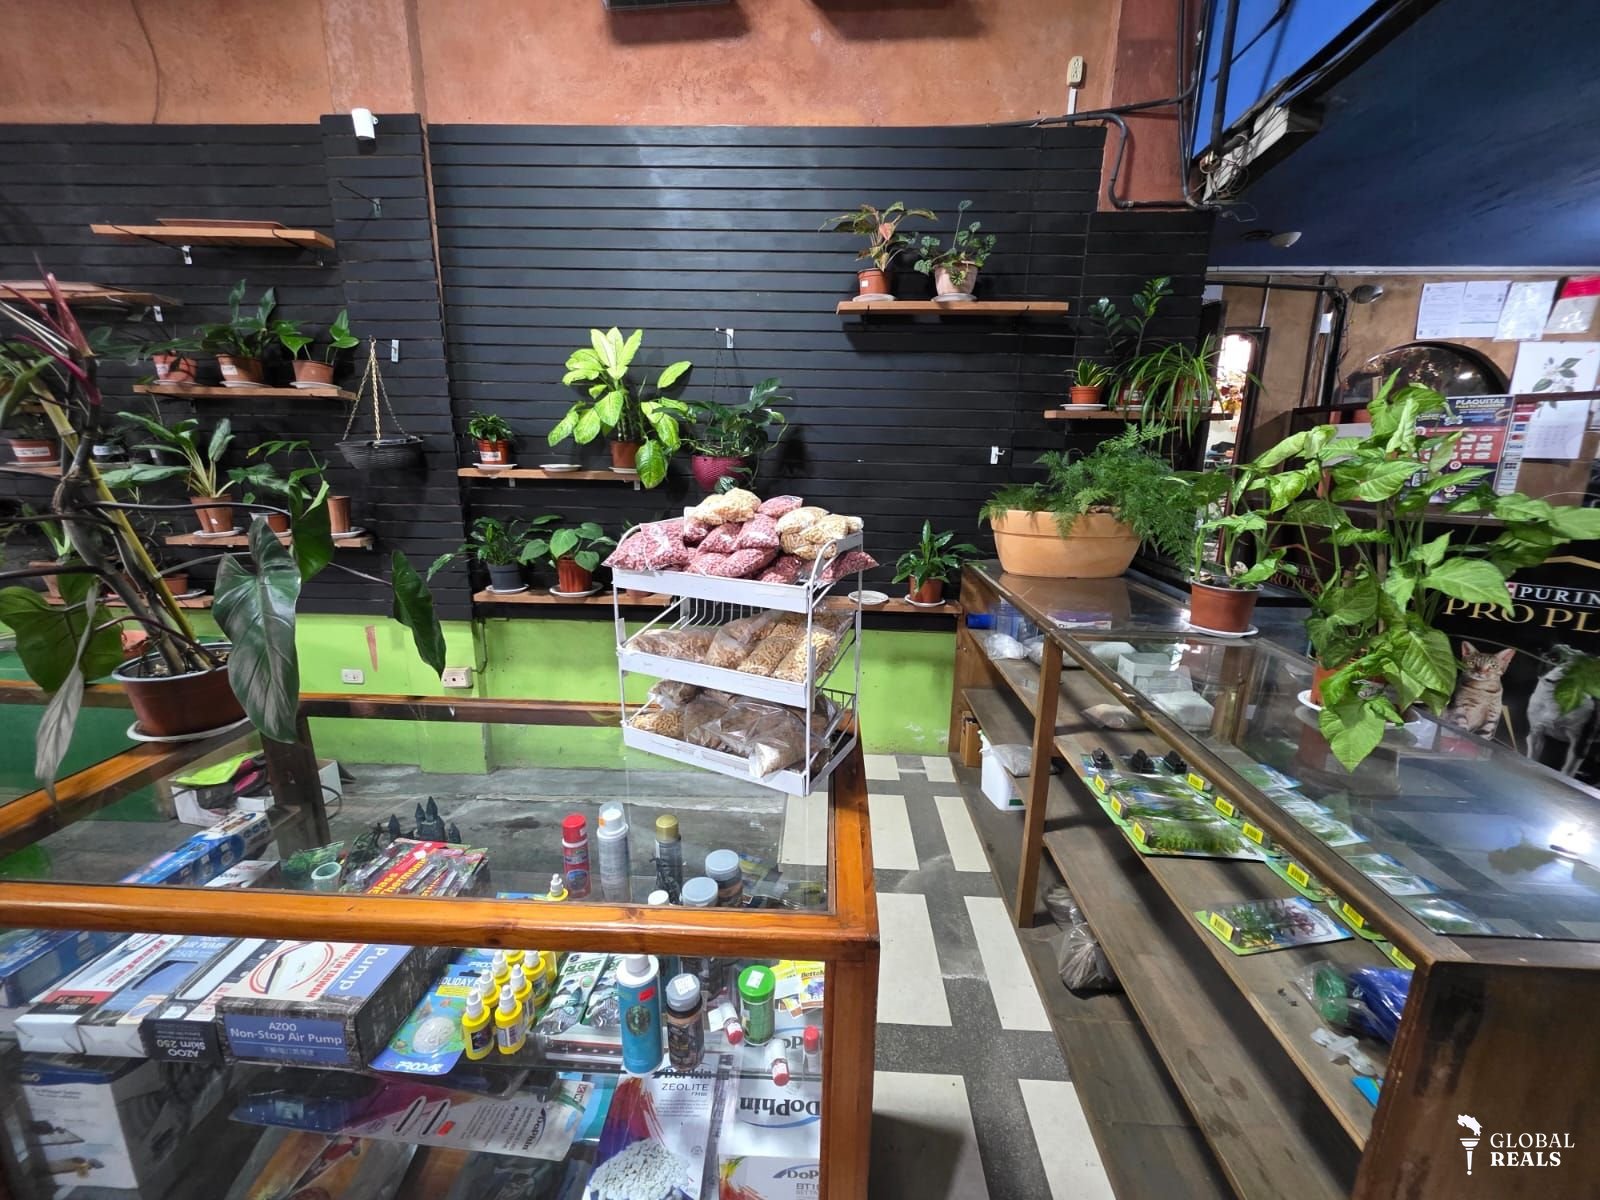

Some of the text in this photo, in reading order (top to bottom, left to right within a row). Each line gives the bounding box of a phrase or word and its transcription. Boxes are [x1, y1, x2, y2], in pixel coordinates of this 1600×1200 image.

[1455, 398, 1506, 406] PLAQUITAS
[339, 947, 389, 991] Pump
[305, 968, 337, 998] TAIWAN
[438, 976, 475, 987] OLIDAY
[268, 1021, 298, 1033] AZOO
[230, 1027, 343, 1047] Non-Stop Air Pump
[661, 1083, 710, 1092] ZEOLITE
[739, 1097, 822, 1117] DoPhin
[786, 1169, 820, 1181] DoP
